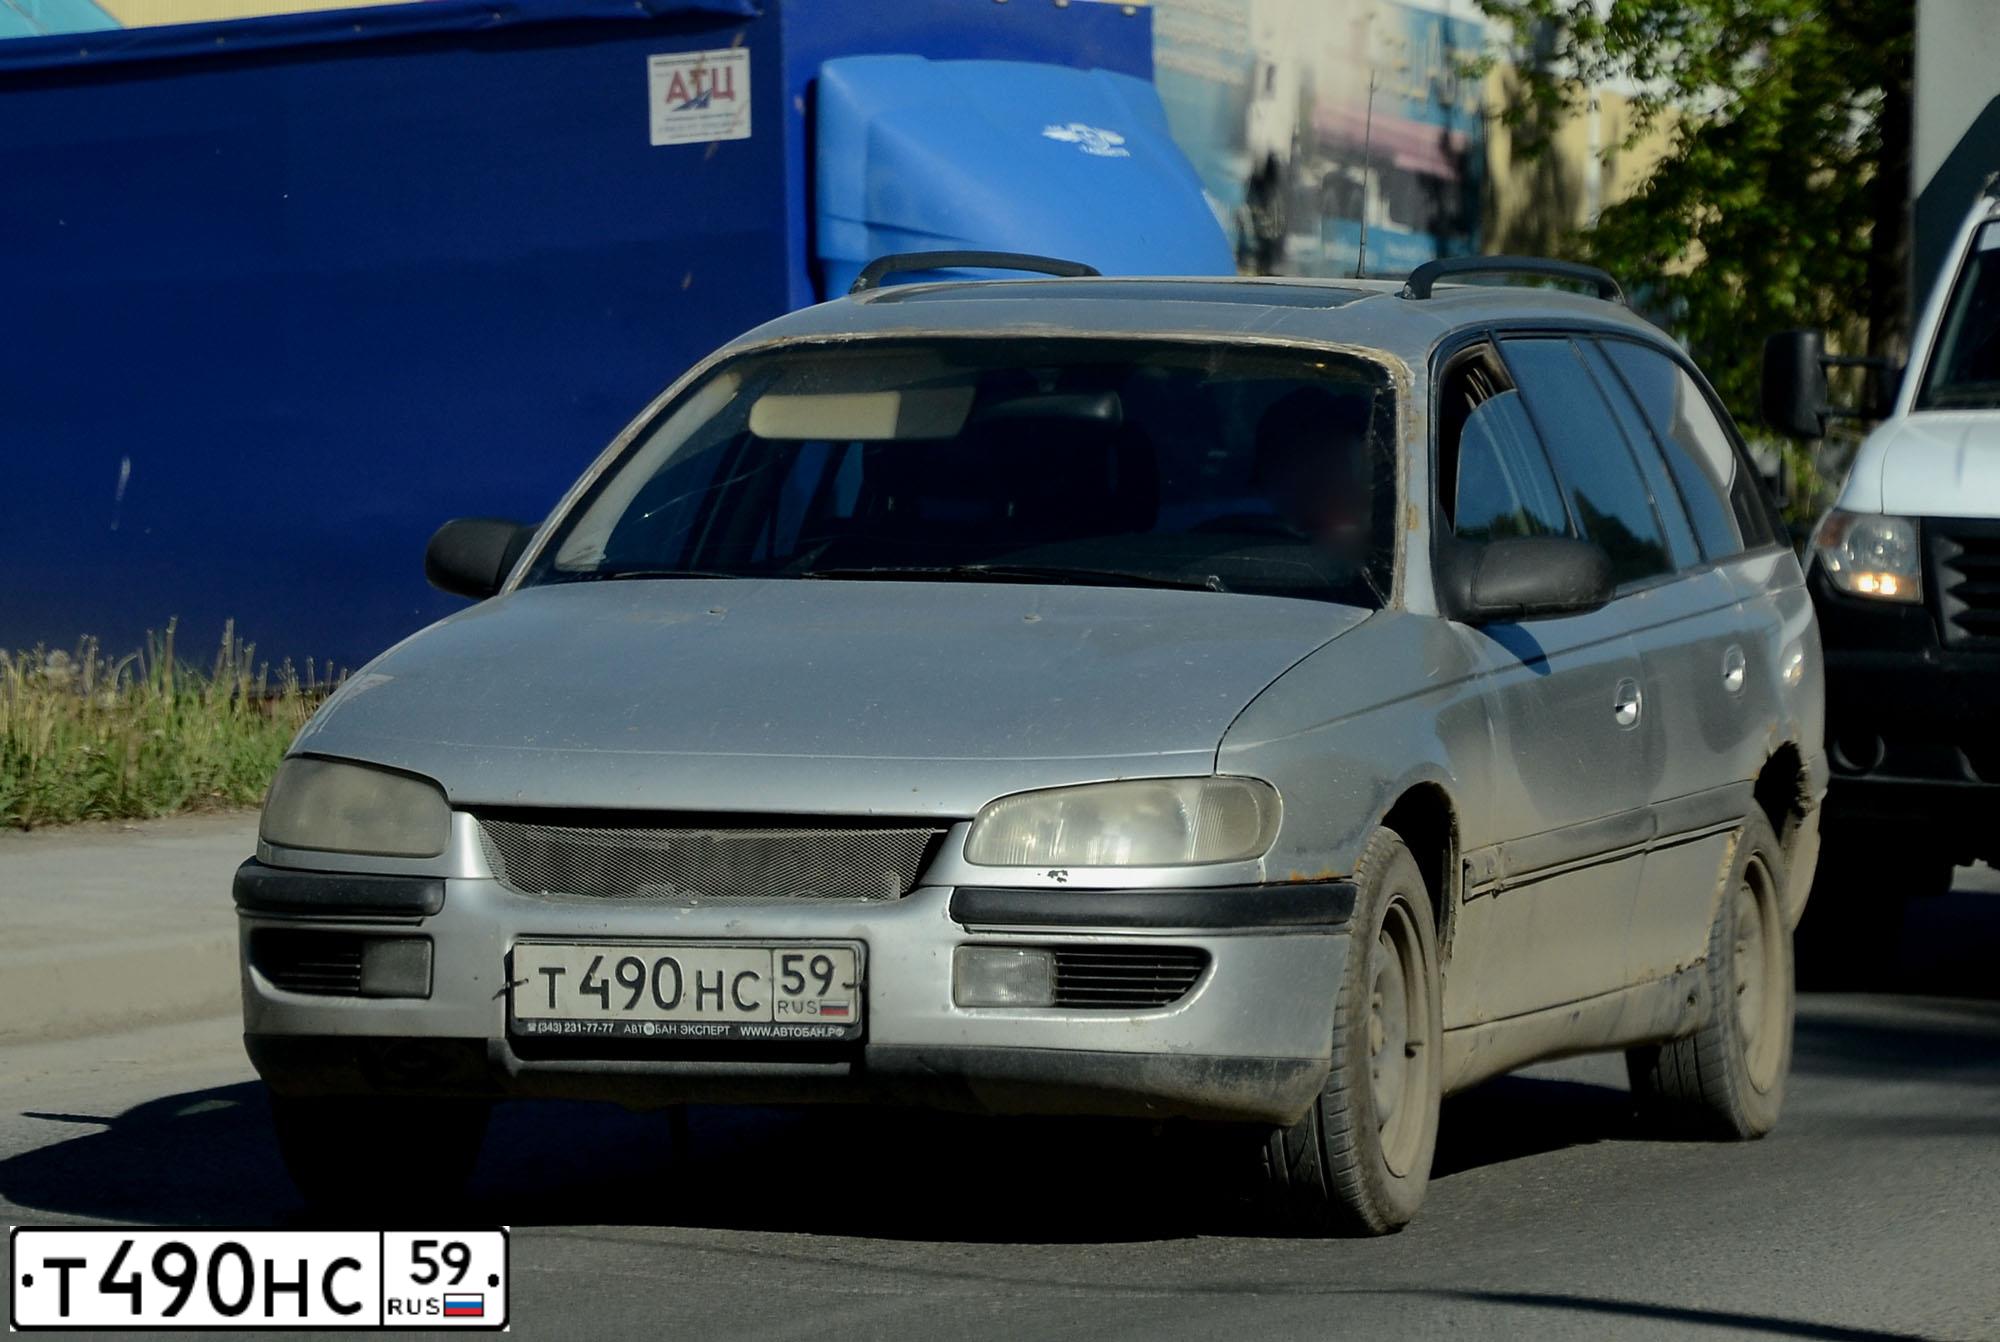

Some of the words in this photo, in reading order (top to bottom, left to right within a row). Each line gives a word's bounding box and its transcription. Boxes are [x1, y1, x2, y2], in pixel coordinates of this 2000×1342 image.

[665, 66, 735, 104] АТЦ
[538, 955, 761, 1012] Т490НС
[781, 954, 835, 997] 59
[777, 1000, 818, 1015] RUS
[538, 1022, 563, 1034] (343)
[564, 1022, 614, 1033] 231-77-77
[680, 1024, 730, 1036] ЭКСПЕРТ
[740, 1026, 846, 1037] WWW.АВТОБАН.РФ
